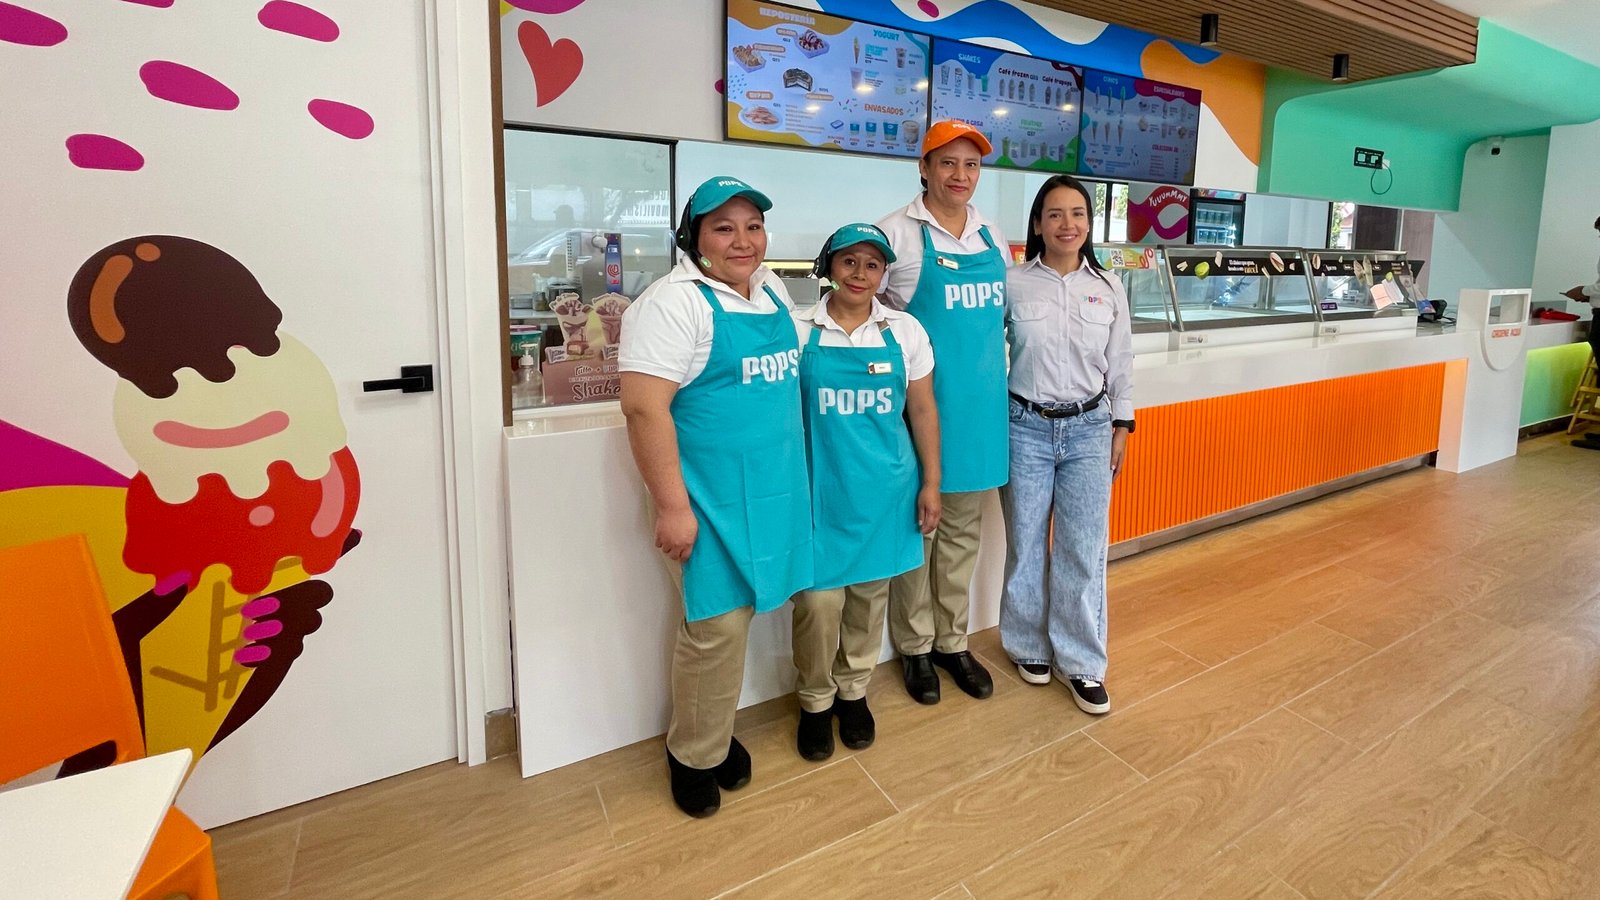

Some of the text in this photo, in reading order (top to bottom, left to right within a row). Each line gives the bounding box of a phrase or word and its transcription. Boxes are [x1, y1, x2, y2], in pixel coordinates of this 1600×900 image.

[873, 29, 900, 41] YOGURT
[958, 53, 981, 64] SHAKES
[864, 103, 904, 116] ENVASADOS
[857, 227, 880, 237] POPS
[944, 281, 1004, 310] POPS
[742, 349, 799, 385] POPS
[818, 387, 893, 415] POPS
